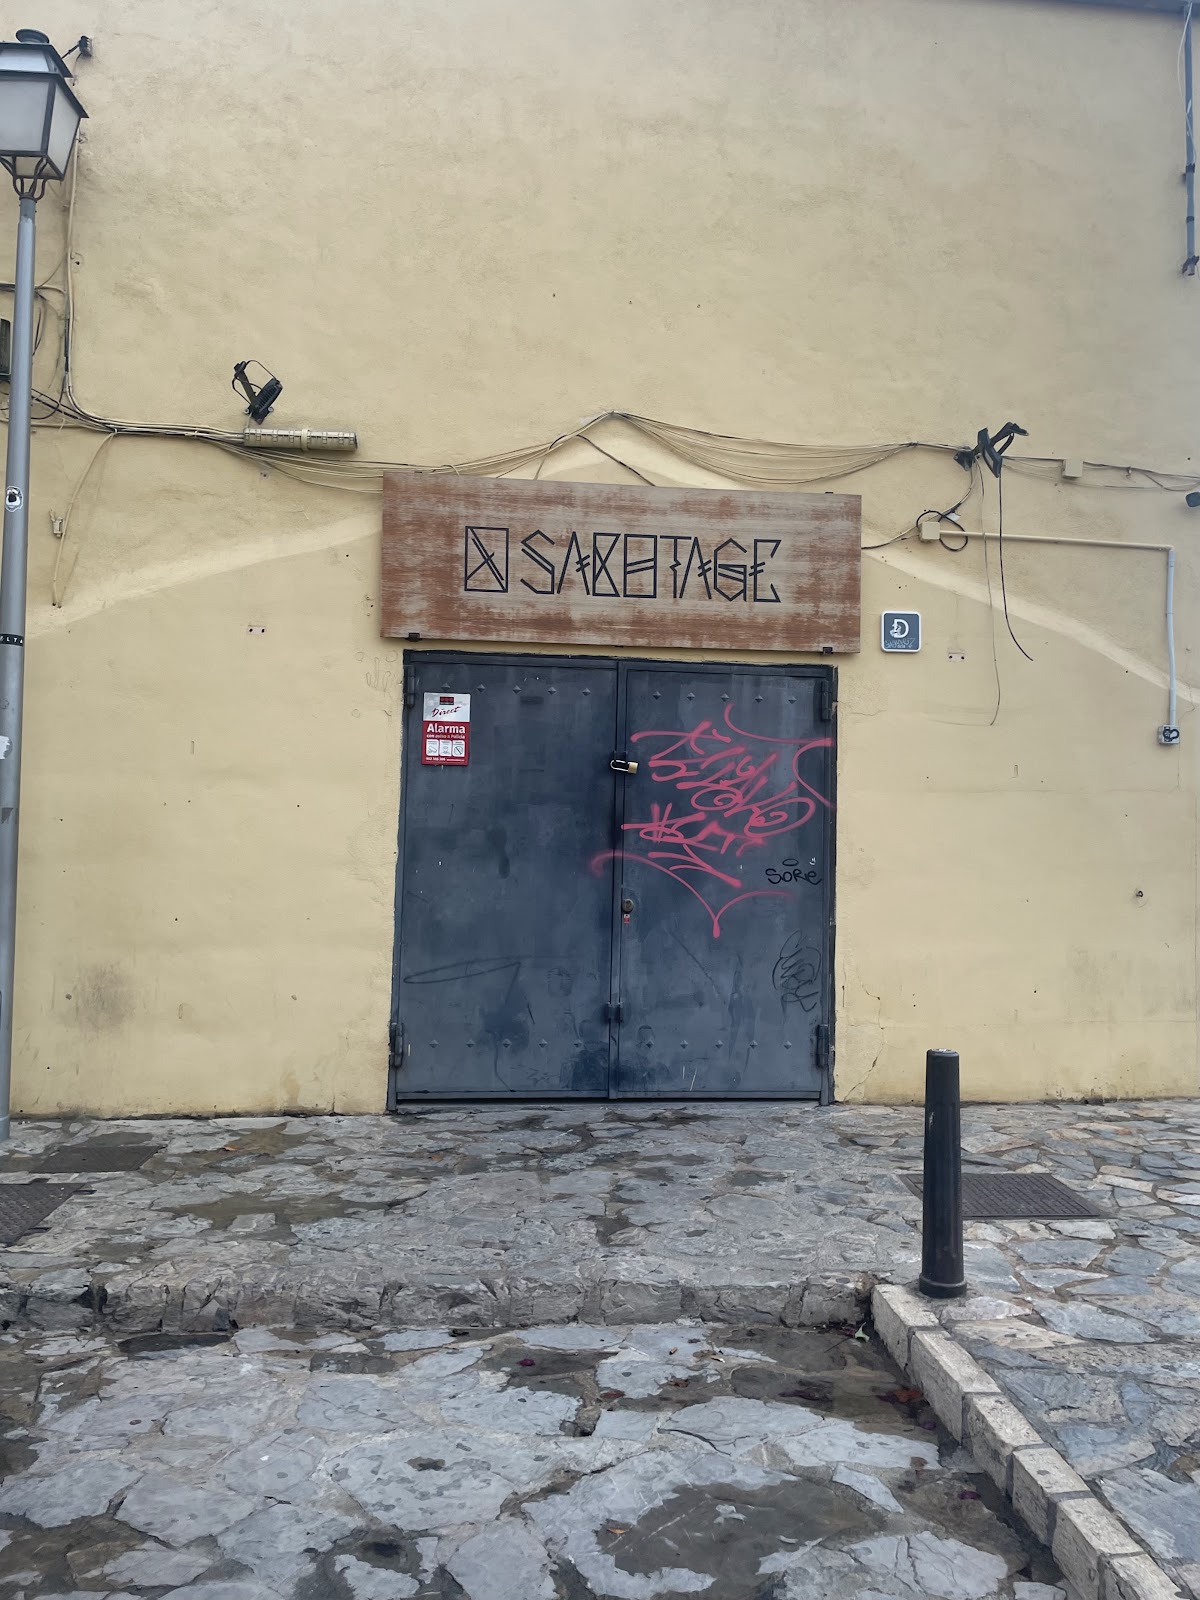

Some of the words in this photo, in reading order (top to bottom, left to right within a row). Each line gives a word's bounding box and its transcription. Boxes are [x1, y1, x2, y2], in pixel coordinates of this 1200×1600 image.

[520, 529, 782, 603] SABOTAGE
[431, 706, 461, 717] Direct
[427, 723, 465, 733] Alarma
